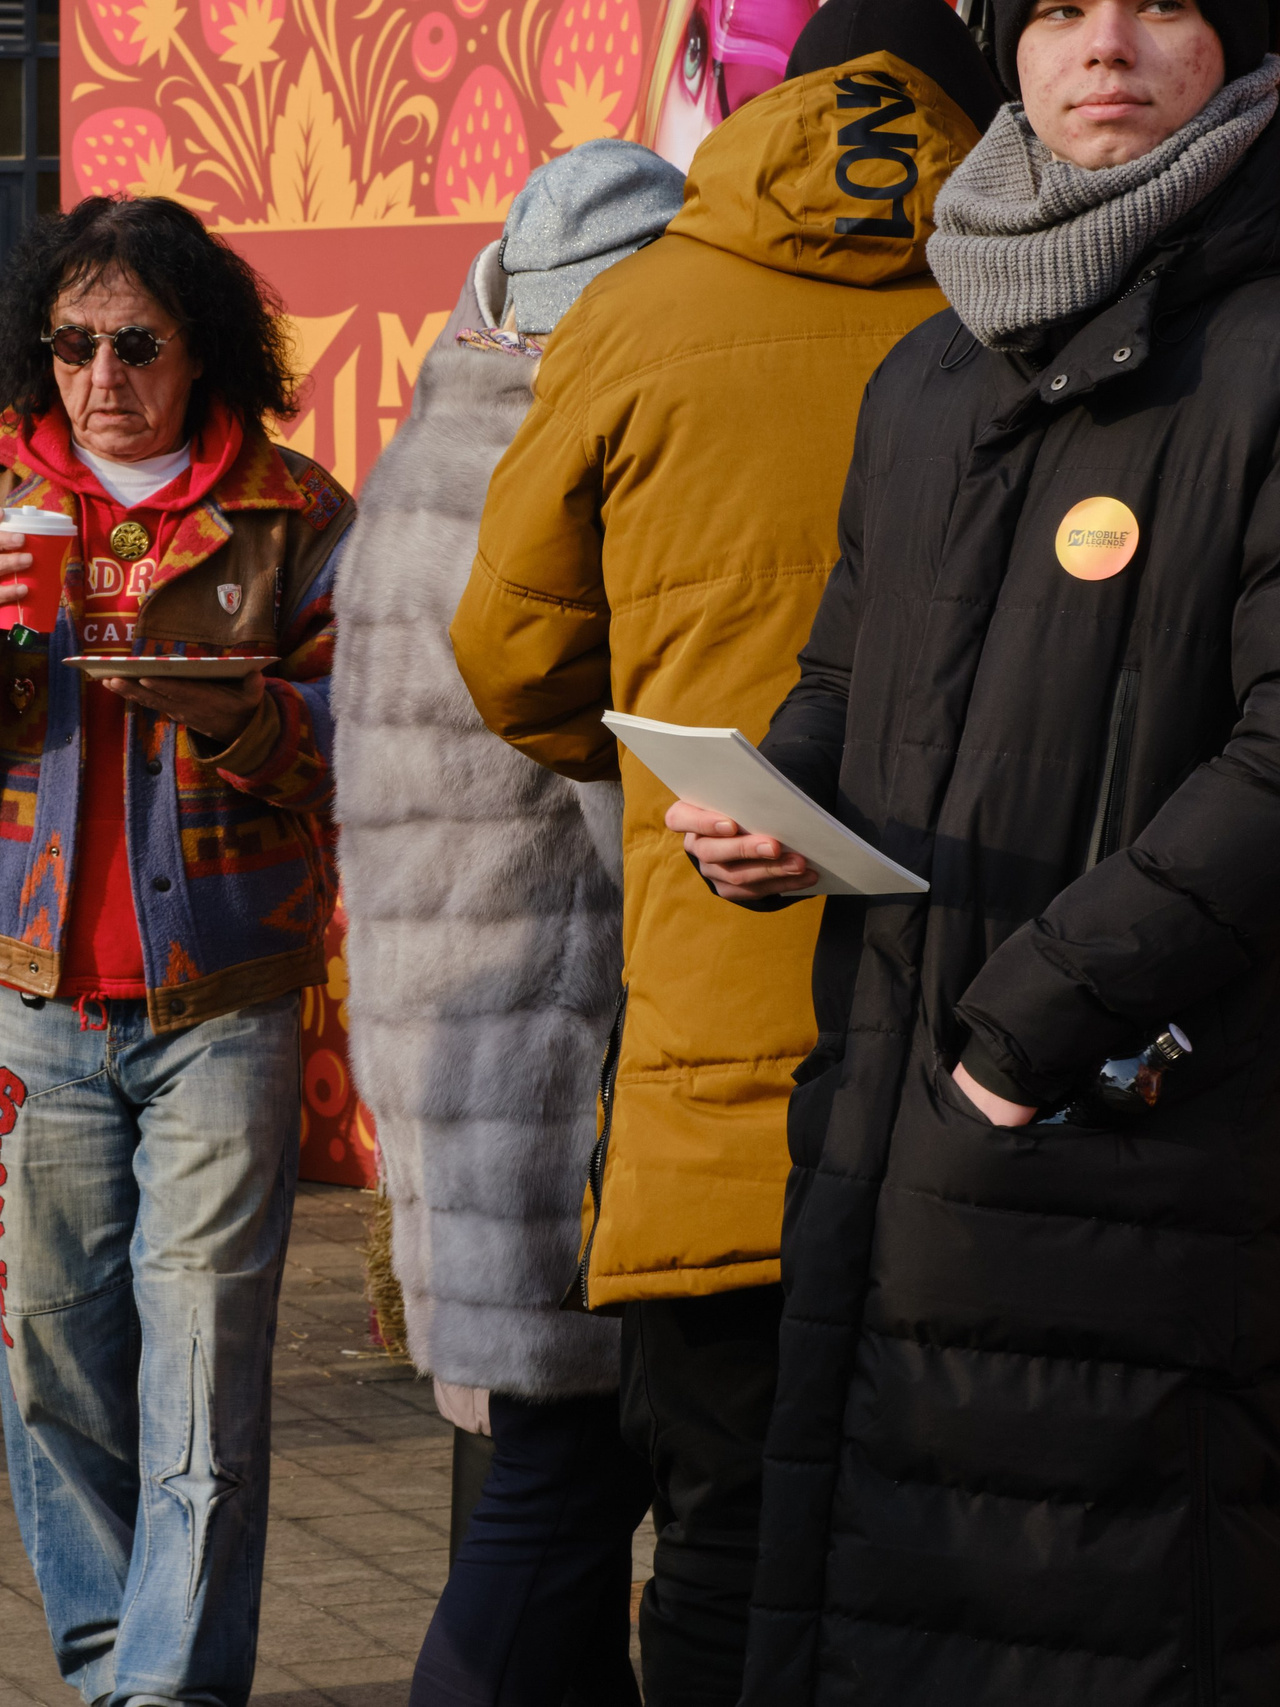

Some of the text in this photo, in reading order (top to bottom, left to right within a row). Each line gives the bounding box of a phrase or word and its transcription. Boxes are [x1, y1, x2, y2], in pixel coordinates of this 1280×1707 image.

[1087, 530, 1131, 540] MOBILE
[1085, 538, 1126, 547] LEGENDS
[86, 557, 124, 599] D
